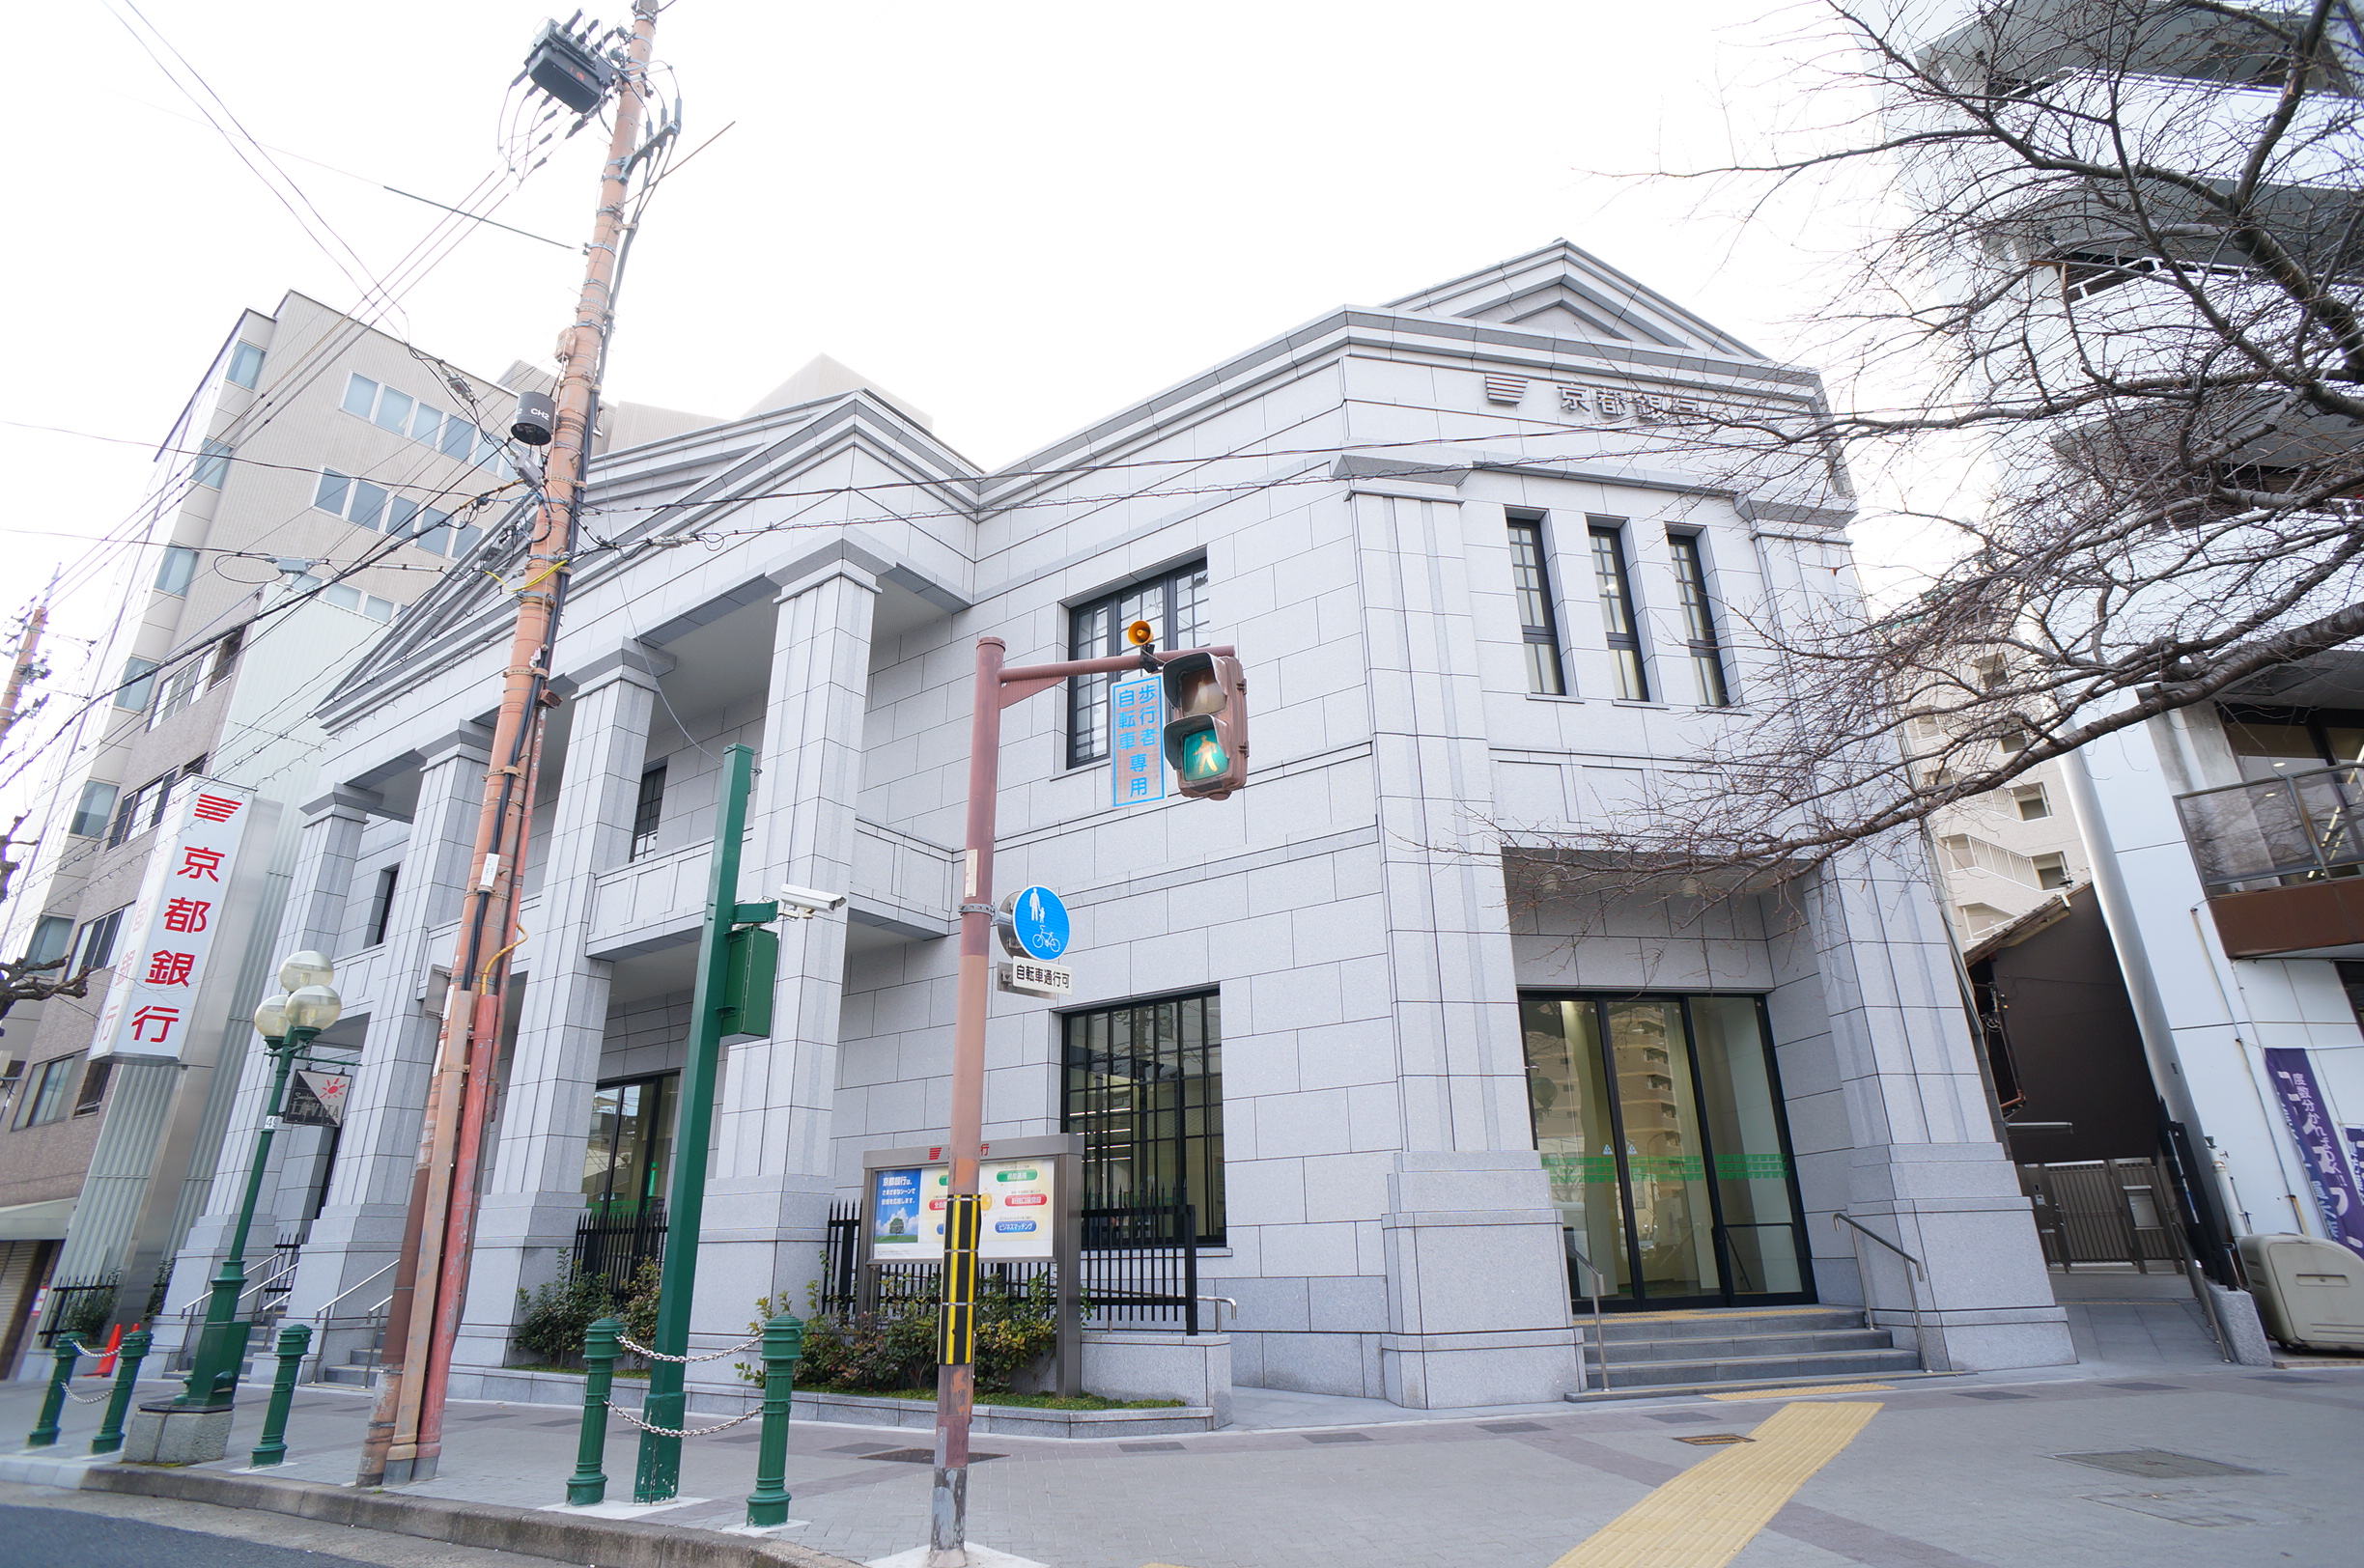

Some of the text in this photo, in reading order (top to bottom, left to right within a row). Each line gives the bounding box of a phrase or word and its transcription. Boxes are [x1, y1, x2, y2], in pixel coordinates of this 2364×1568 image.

[530, 407, 549, 421] CH2
[1117, 688, 1137, 750] 自転車
[1138, 684, 1158, 746] 歩行者
[1129, 753, 1148, 798] 専用
[130, 846, 226, 1044] 京都銀行
[1016, 964, 1070, 989] 自転車通行可
[999, 1222, 1033, 1231] ビジネスマッチング
